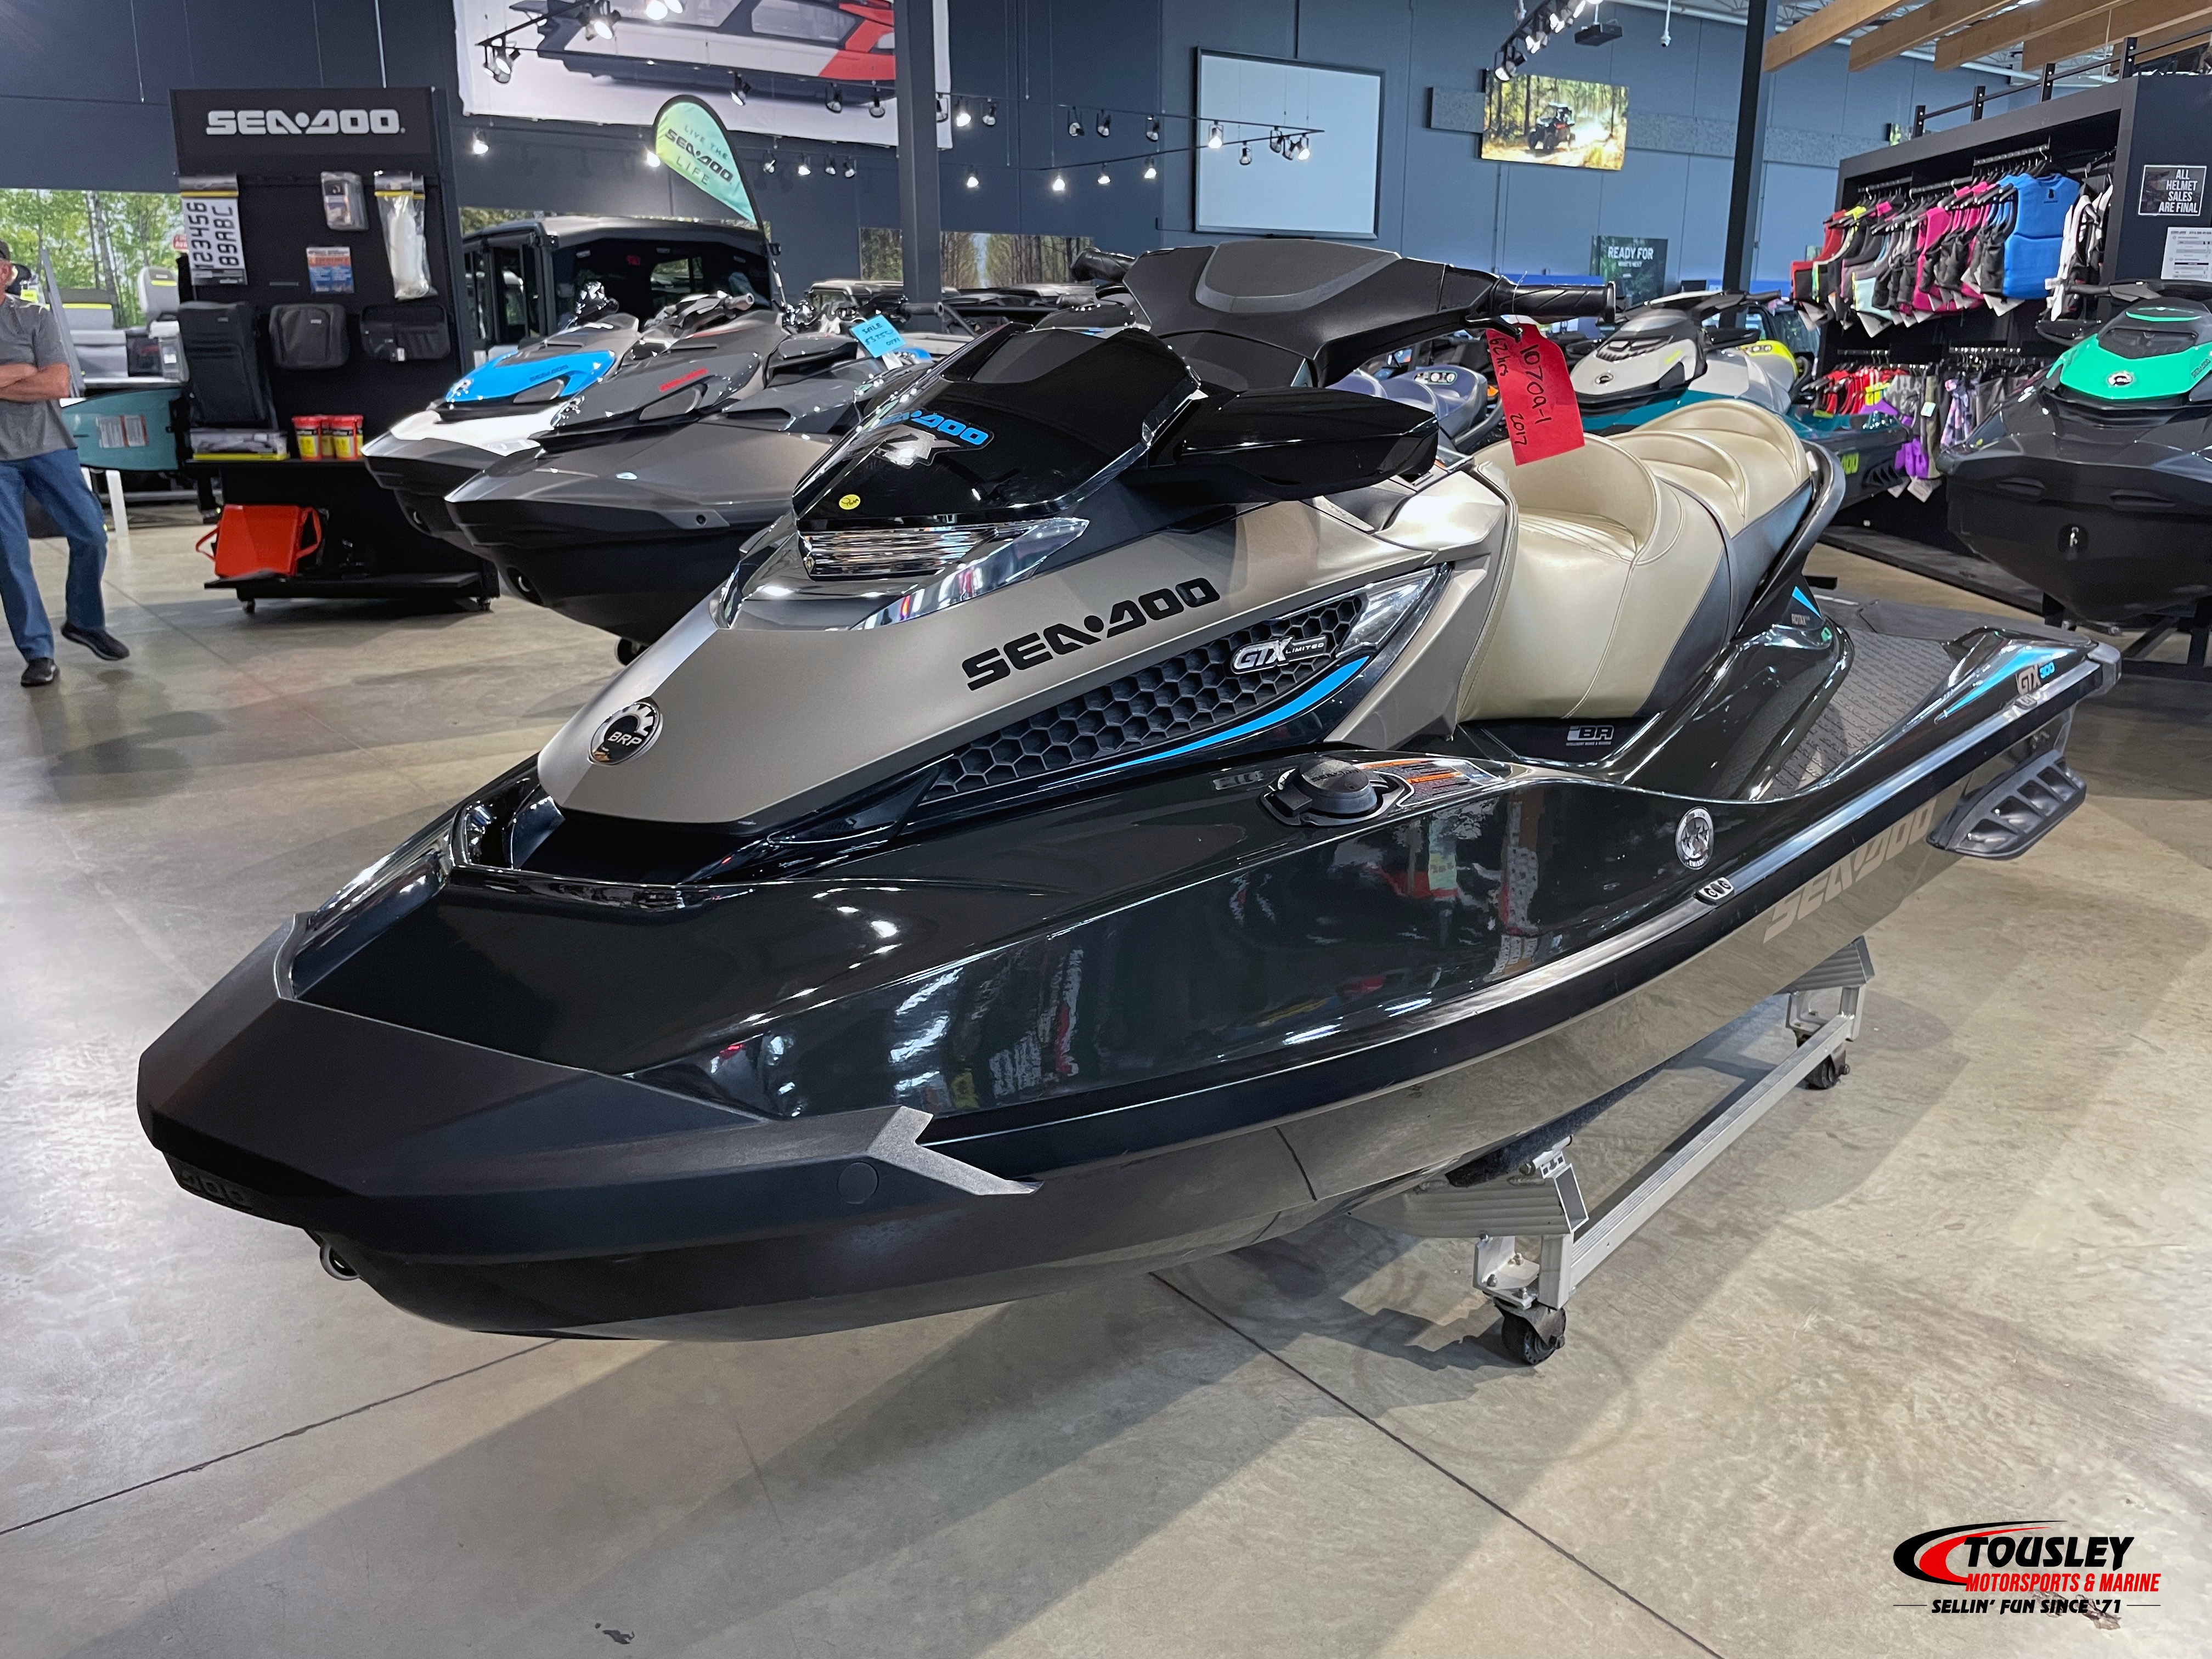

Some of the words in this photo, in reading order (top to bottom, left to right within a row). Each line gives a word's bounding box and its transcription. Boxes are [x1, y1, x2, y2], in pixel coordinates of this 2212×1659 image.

[685, 125, 706, 143] LIVE
[710, 143, 728, 160] THE
[676, 156, 710, 185] LIFE
[2175, 169, 2190, 180] ALL
[2166, 179, 2198, 191] HELMET
[2168, 191, 2193, 202] SALES
[2158, 202, 2175, 213] ARE
[2176, 202, 2198, 213] FINAL
[1608, 246, 1636, 259] READY
[1637, 247, 1654, 260] FOR
[862, 323, 883, 334] SALE
[1510, 413, 1527, 445] 2017
[1234, 636, 1294, 670] GTX
[1285, 642, 1324, 654] LIMITED
[2018, 663, 2041, 696] GTX
[608, 731, 642, 746] BRP
